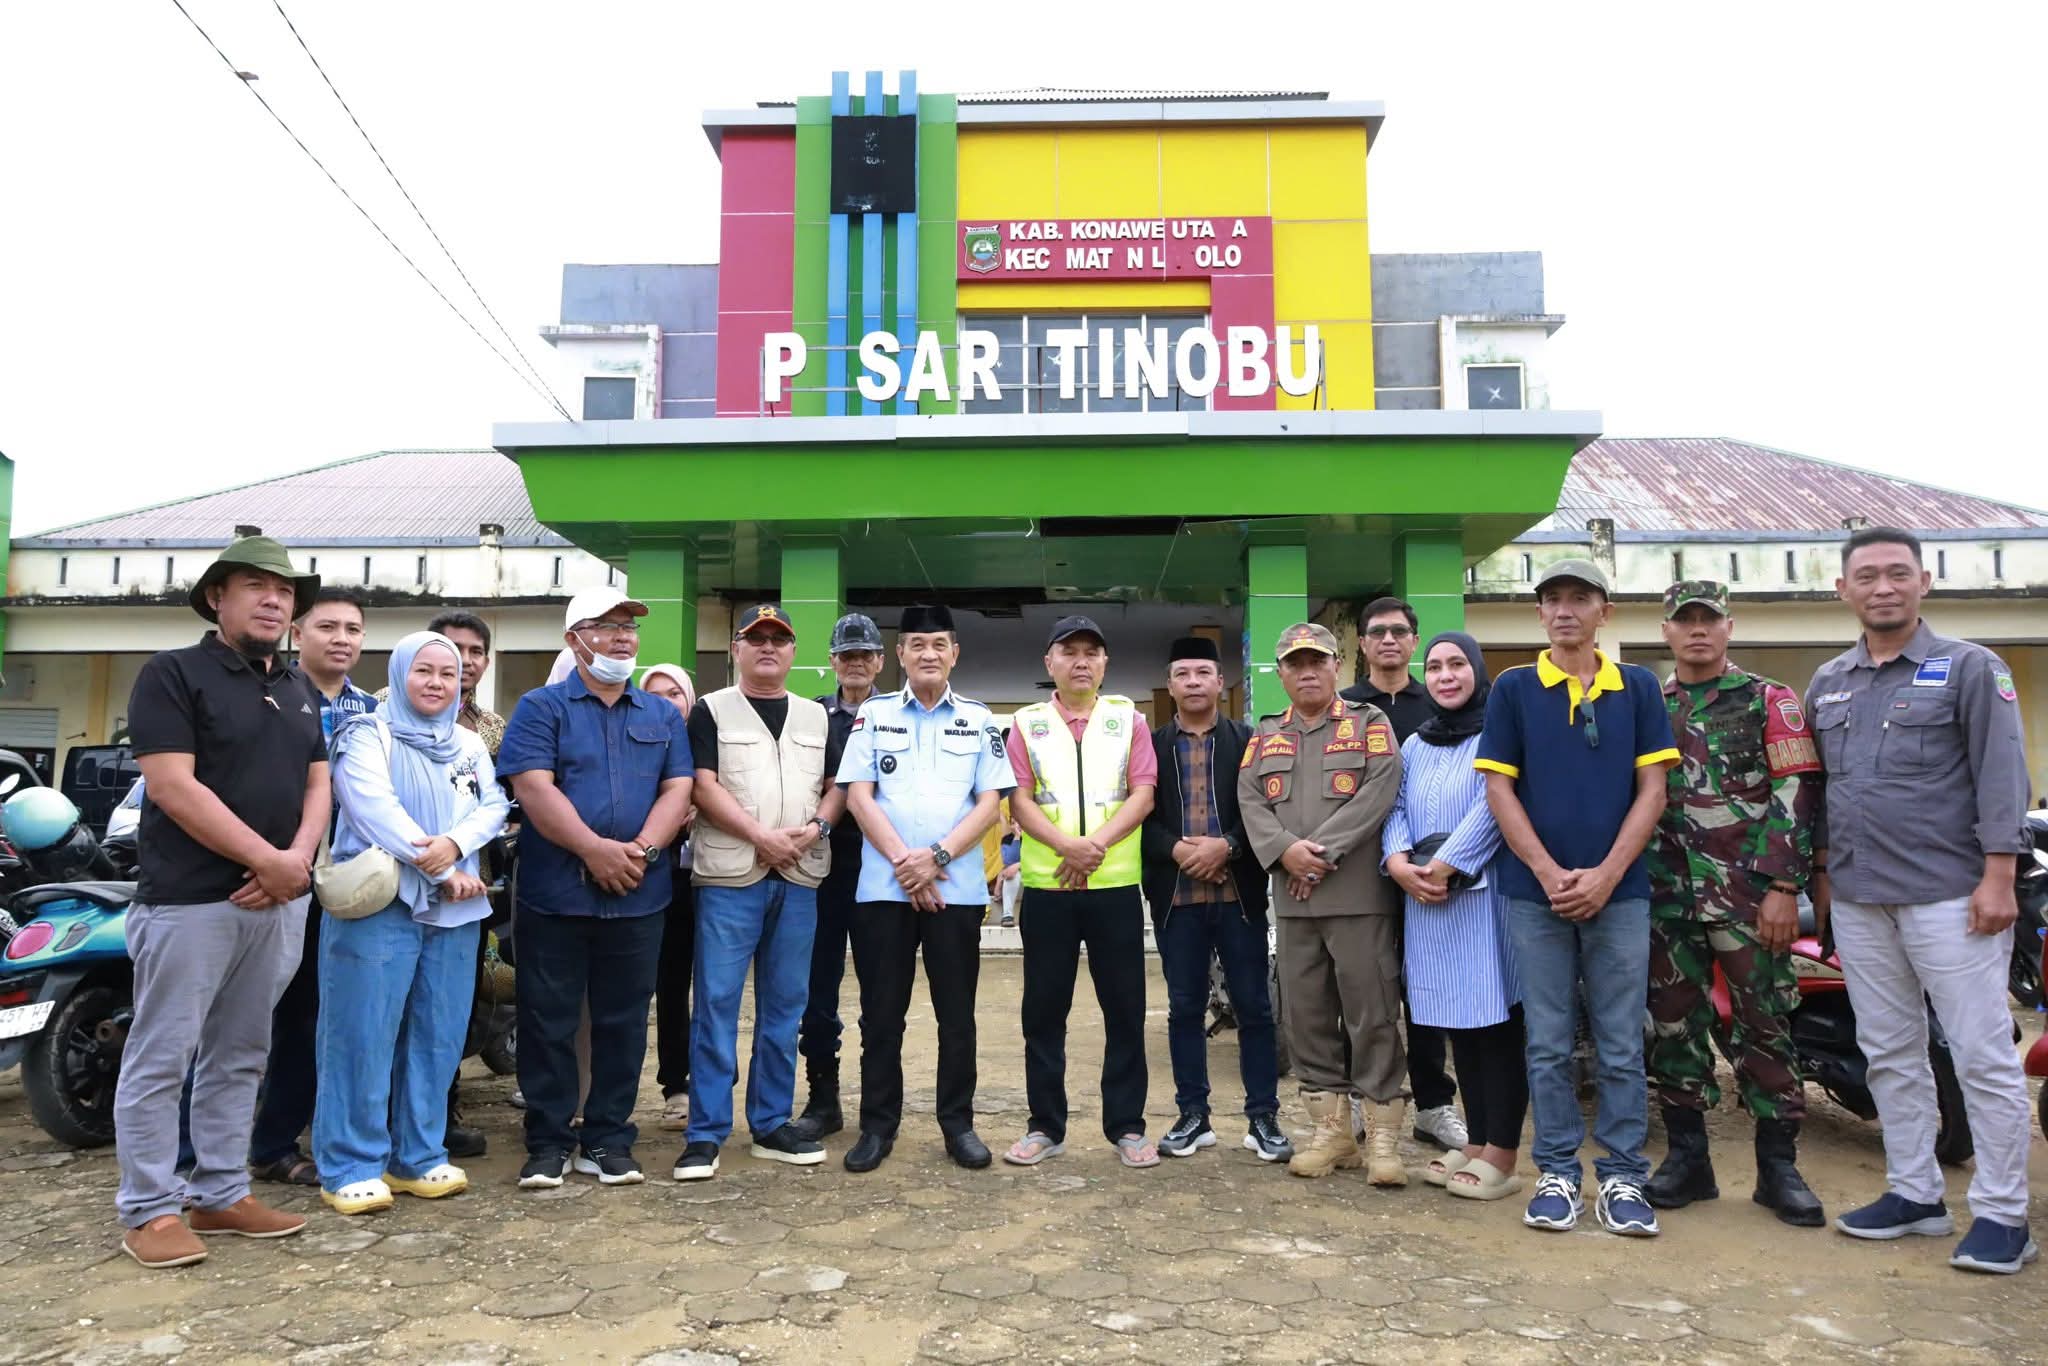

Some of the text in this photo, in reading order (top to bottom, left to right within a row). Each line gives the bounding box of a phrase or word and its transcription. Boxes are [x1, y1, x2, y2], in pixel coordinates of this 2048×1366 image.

[1009, 222, 1064, 240] KAB.
[1071, 221, 1164, 239] KONAWE
[1046, 325, 1320, 399] TINOBU
[1326, 741, 1362, 752] POL PP
